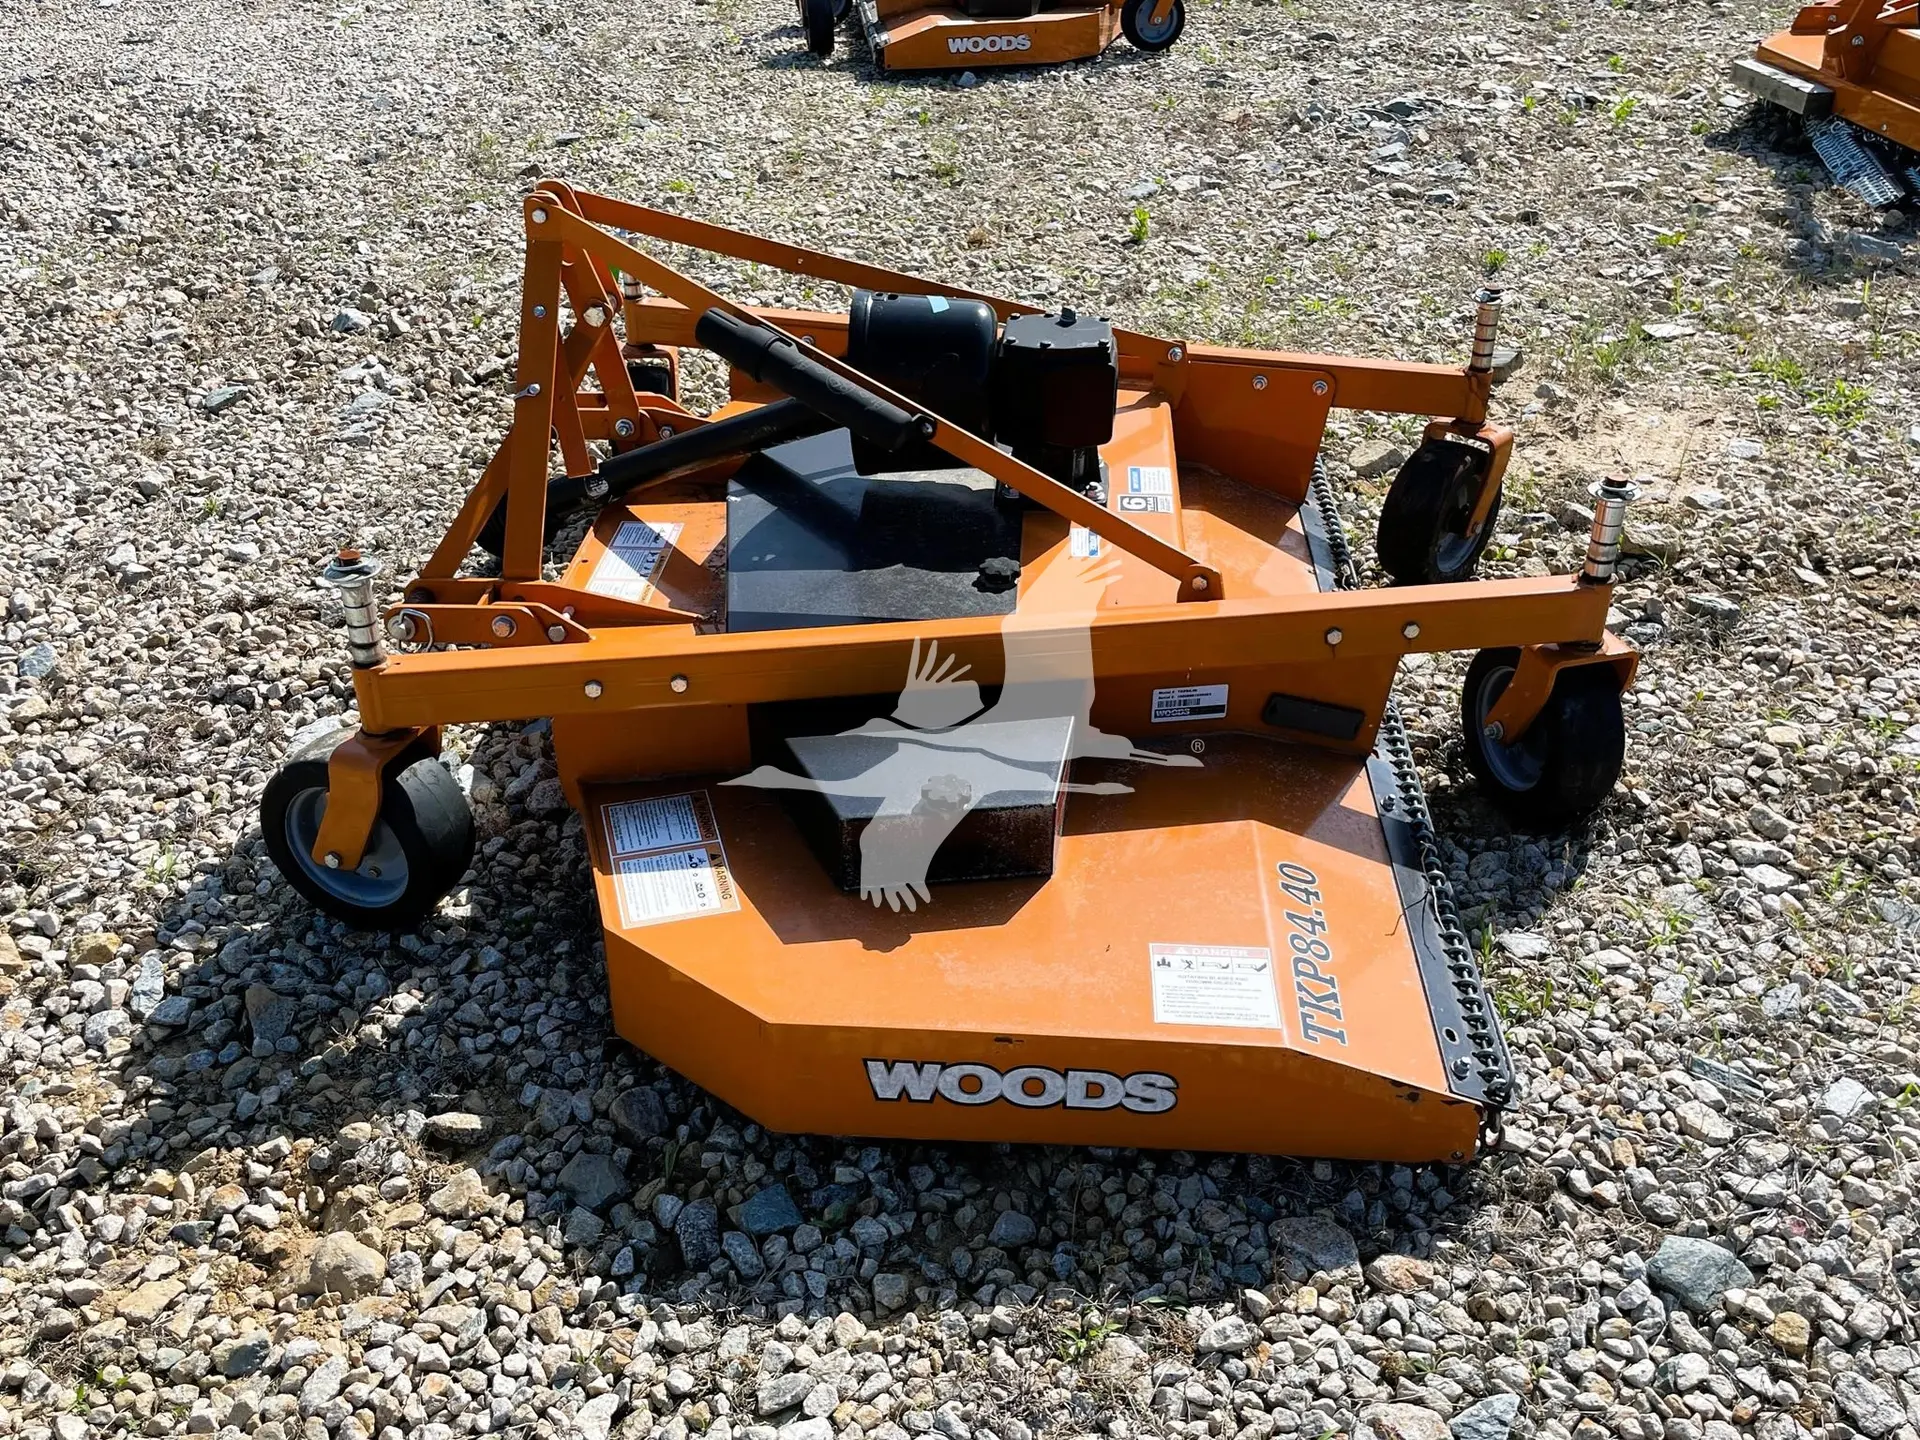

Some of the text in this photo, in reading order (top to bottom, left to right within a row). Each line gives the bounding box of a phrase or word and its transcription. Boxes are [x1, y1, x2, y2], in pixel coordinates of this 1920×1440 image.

[947, 34, 1031, 53] WOODS
[713, 862, 732, 900] WARNING
[1277, 862, 1348, 1046] TKP84.40
[863, 1058, 1180, 1115] WOODS
